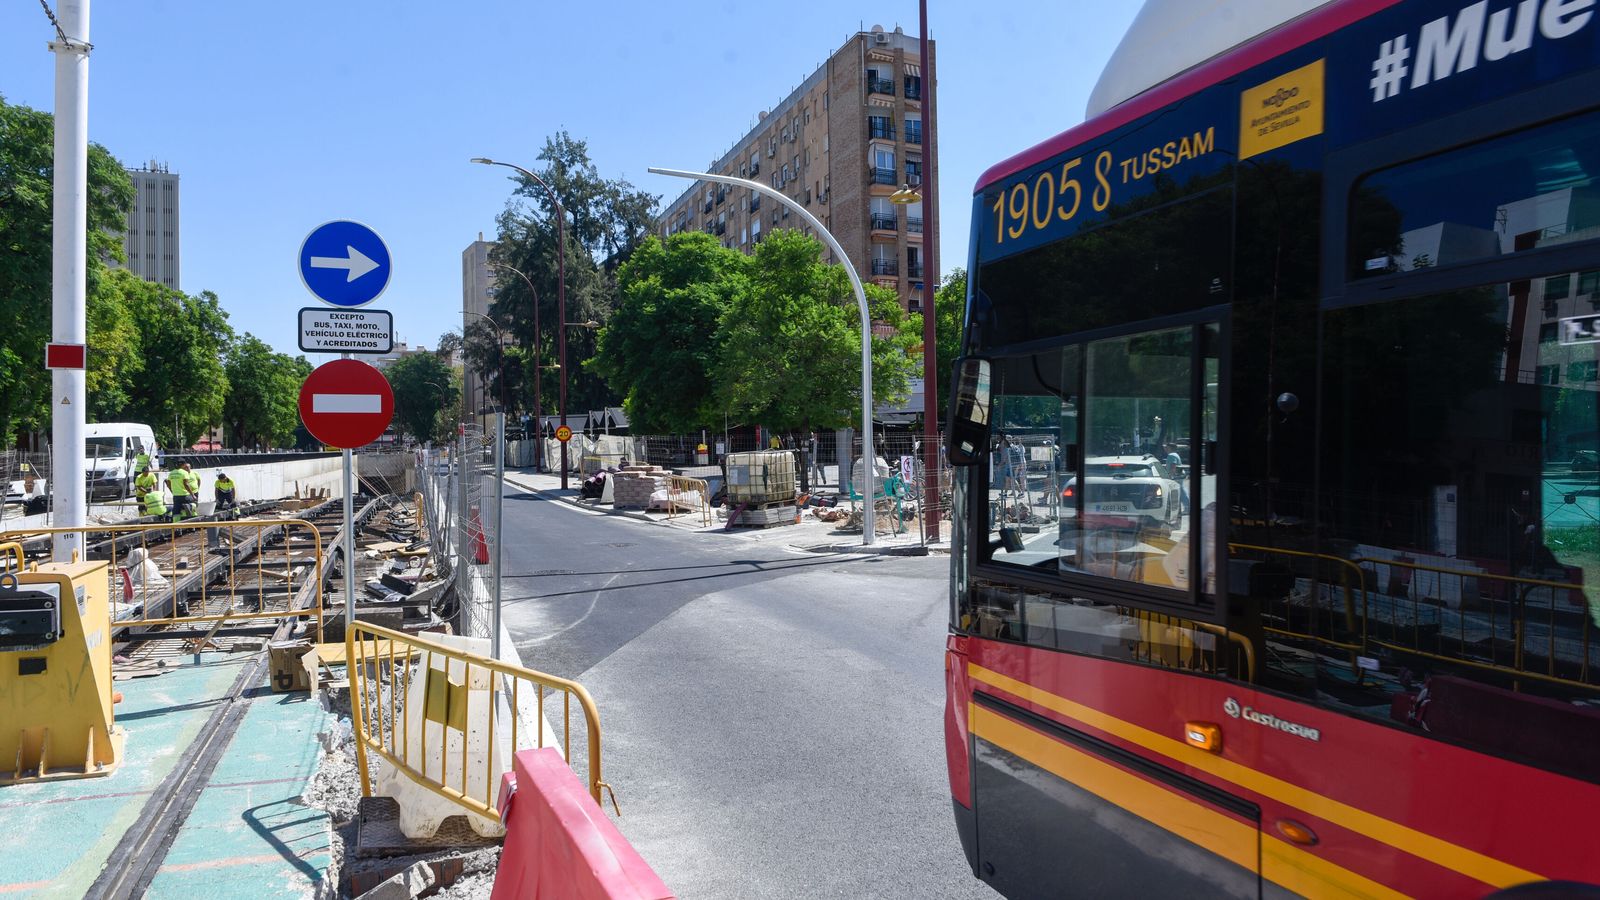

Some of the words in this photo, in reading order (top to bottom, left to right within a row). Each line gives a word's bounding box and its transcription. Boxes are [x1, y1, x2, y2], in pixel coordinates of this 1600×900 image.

[993, 157, 1082, 244] 1905
[1120, 126, 1215, 184] TUSSAM
[329, 313, 365, 321] EXCEPTO
[313, 321, 332, 329] BUS,
[333, 322, 354, 330] TAXI,
[355, 323, 380, 331] MOTO,
[305, 329, 345, 338] VEHÍCULO
[346, 330, 389, 340] ELÉCTRICO
[316, 339, 322, 347] Y
[323, 340, 378, 348] ACREDITADOS
[1242, 706, 1321, 742] Castrosua
